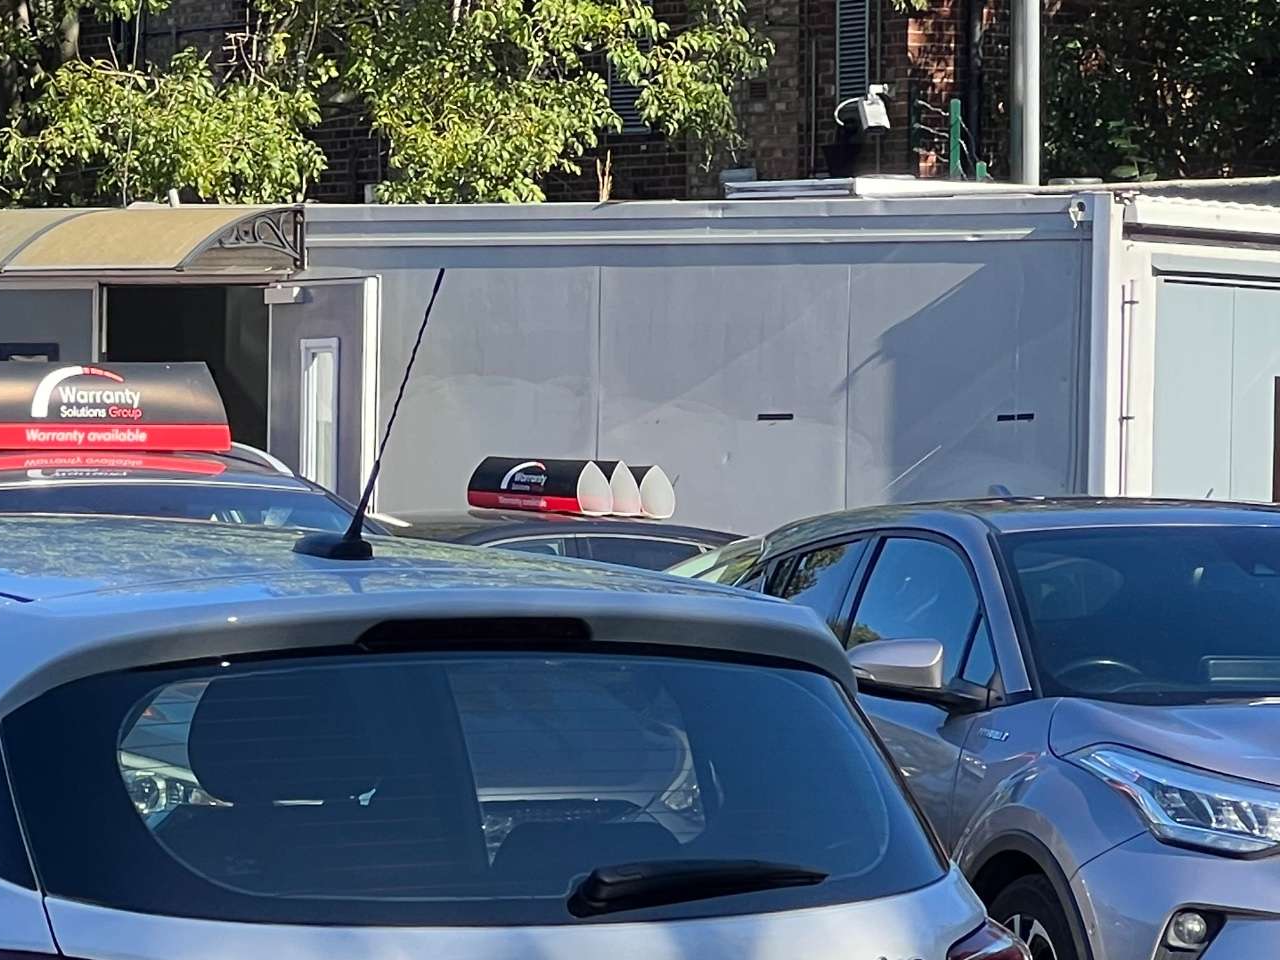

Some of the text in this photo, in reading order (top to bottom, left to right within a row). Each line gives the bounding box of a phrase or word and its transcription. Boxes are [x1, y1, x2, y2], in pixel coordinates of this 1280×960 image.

[59, 386, 140, 408] Warranty
[60, 405, 142, 420] Solutions Group
[25, 428, 148, 445] Warranty available
